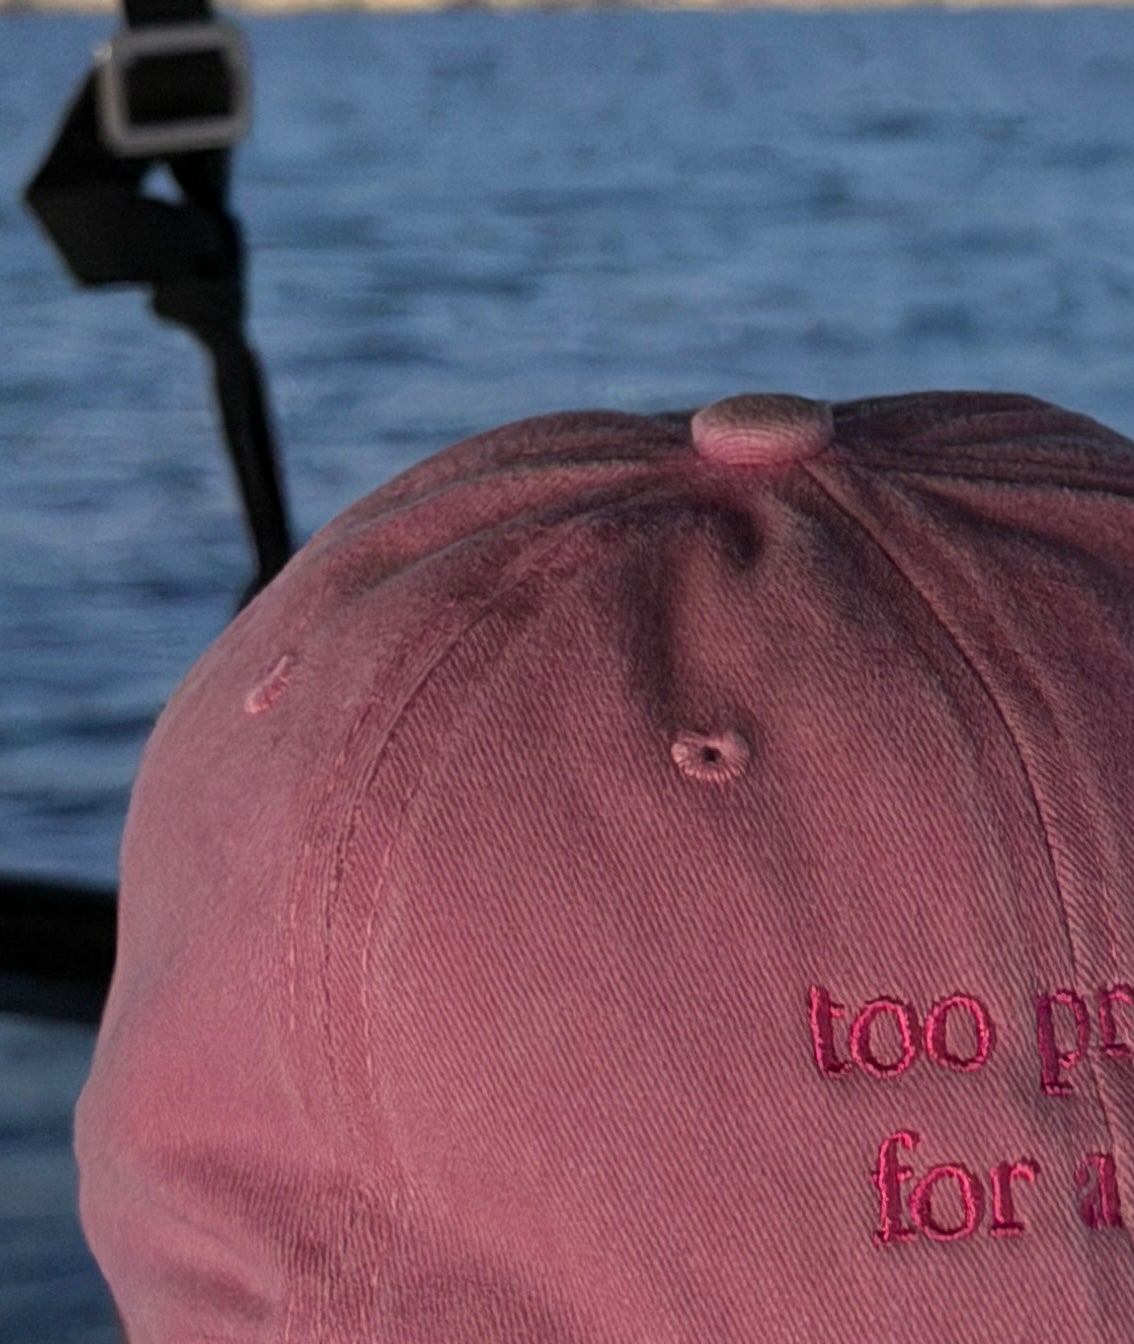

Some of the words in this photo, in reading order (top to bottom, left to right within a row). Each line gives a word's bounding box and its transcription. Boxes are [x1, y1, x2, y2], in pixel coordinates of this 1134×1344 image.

[809, 984, 993, 1080] too
[872, 1129, 1040, 1247] for
[1074, 1154, 1122, 1229] a
